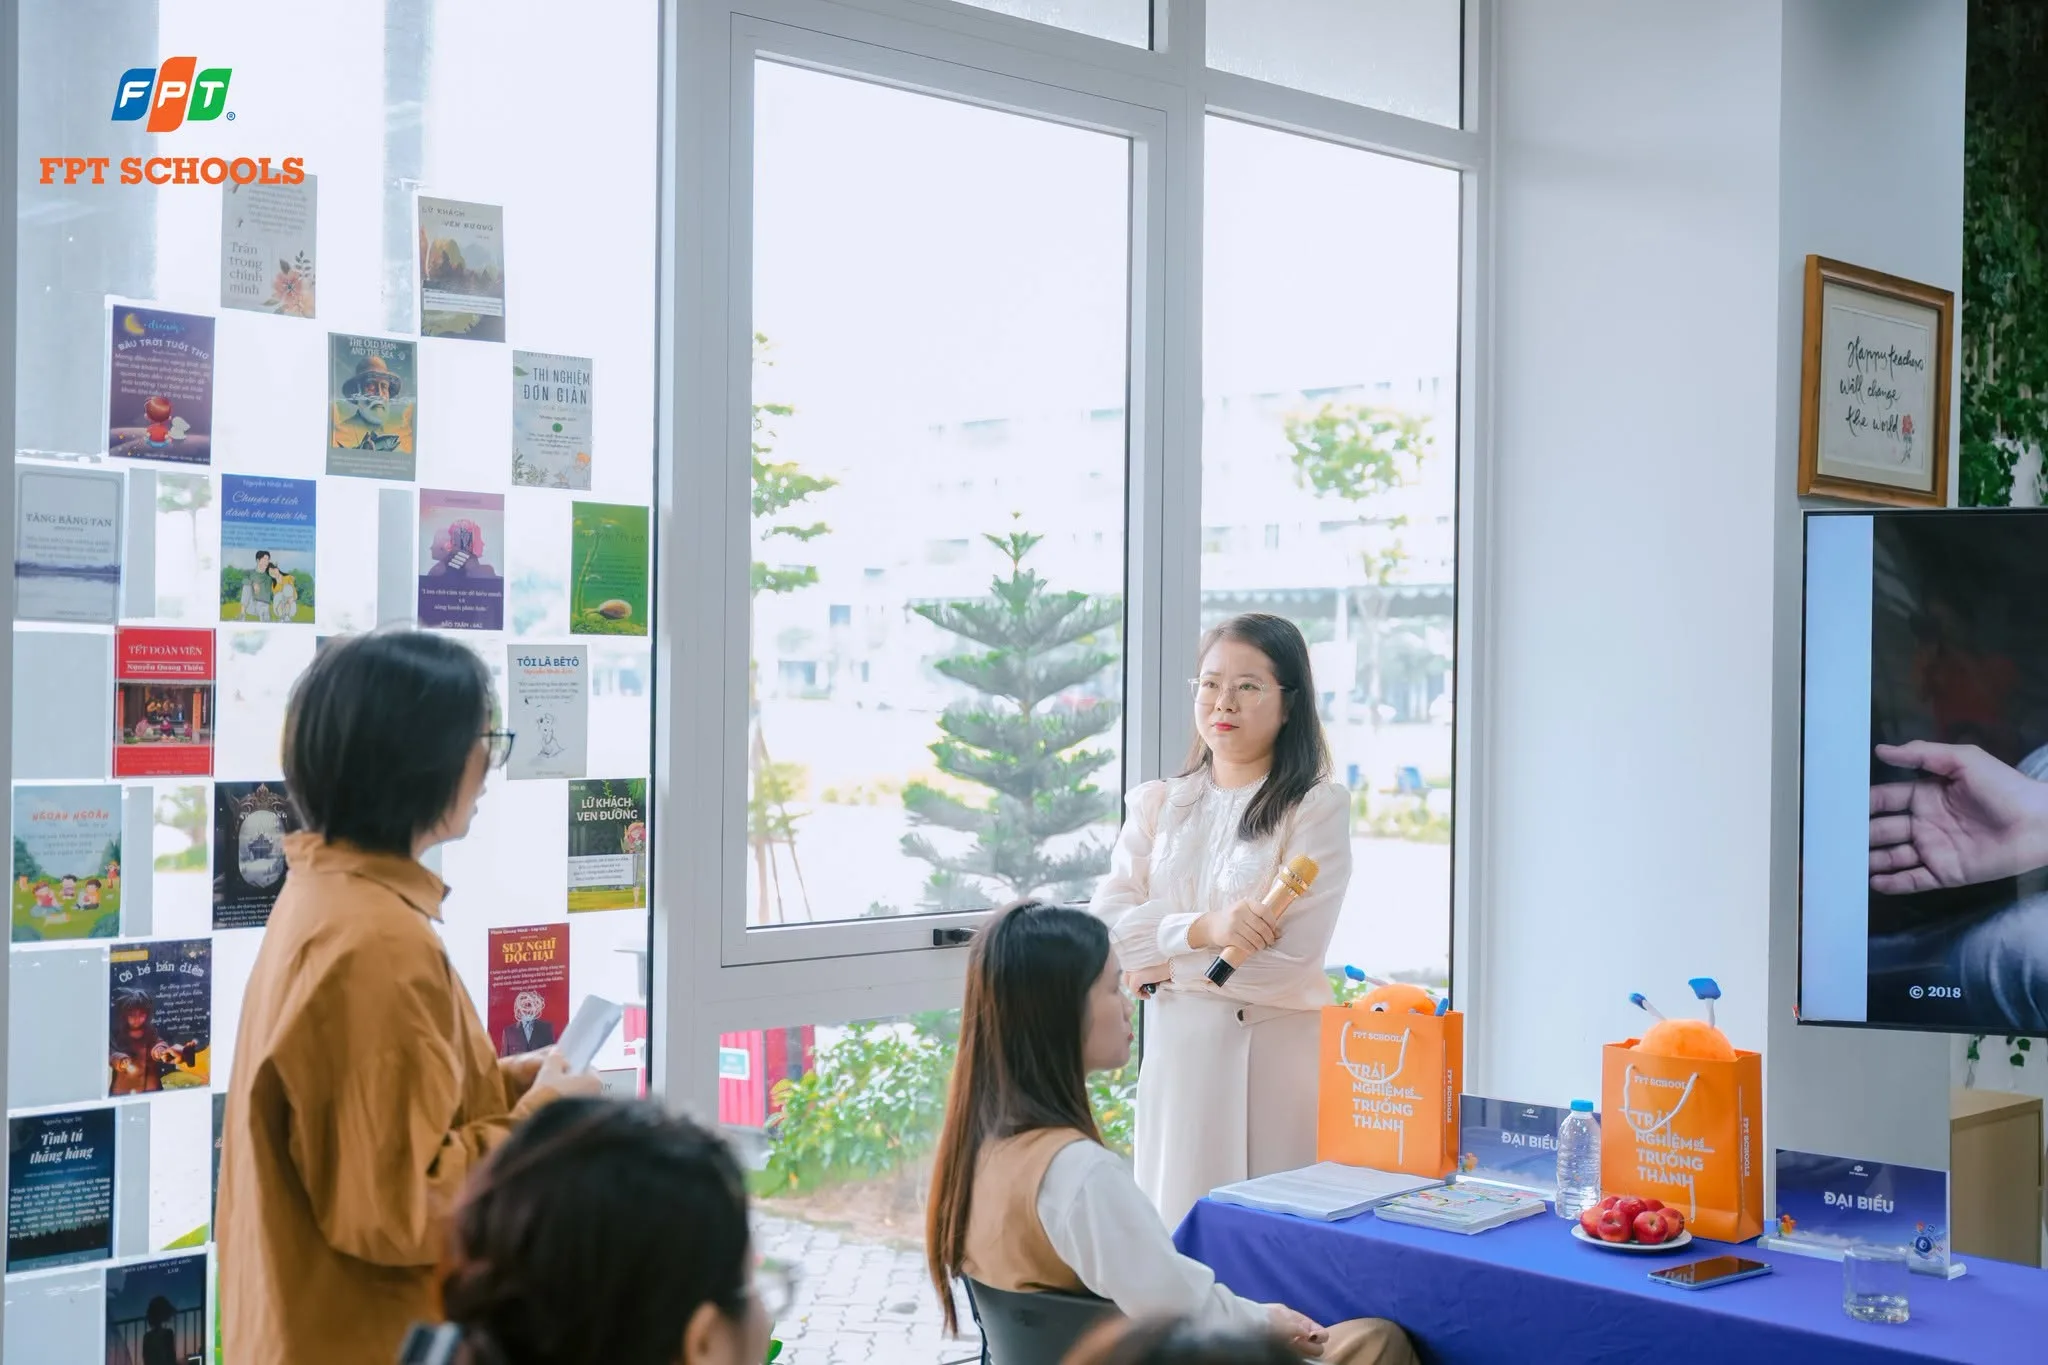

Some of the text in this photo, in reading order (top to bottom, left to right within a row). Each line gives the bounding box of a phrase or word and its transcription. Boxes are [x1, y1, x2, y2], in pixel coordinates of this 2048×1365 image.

[350, 338, 362, 347] THE
[364, 339, 379, 349] OLD
[1847, 336, 1924, 381] Happy teachers
[524, 384, 587, 404] ĐƠN GIẢN
[1867, 376, 1900, 410] change
[1845, 405, 1900, 443] the world
[129, 643, 147, 655] TẾT
[517, 655, 537, 667] TÔI
[553, 656, 580, 667] BÊTÔ
[581, 795, 632, 809] LỮ KHÁCH
[576, 807, 638, 821] VEN ĐƯỜNG
[502, 941, 525, 954] SUY
[526, 937, 557, 952] NGHĨ
[136, 963, 151, 976] bé
[156, 960, 175, 972] bán
[1928, 985, 1962, 998] 2018
[1368, 1032, 1405, 1043] SCHOOL
[1650, 1078, 1688, 1090] SCHOOL
[1352, 1113, 1404, 1133] THÀNH
[1501, 1132, 1559, 1151] ĐẠI BIỂU
[65, 1145, 94, 1161] hàng
[1637, 1165, 1695, 1188] THÀNH
[1823, 1191, 1894, 1214] ĐẠI BIỂU
